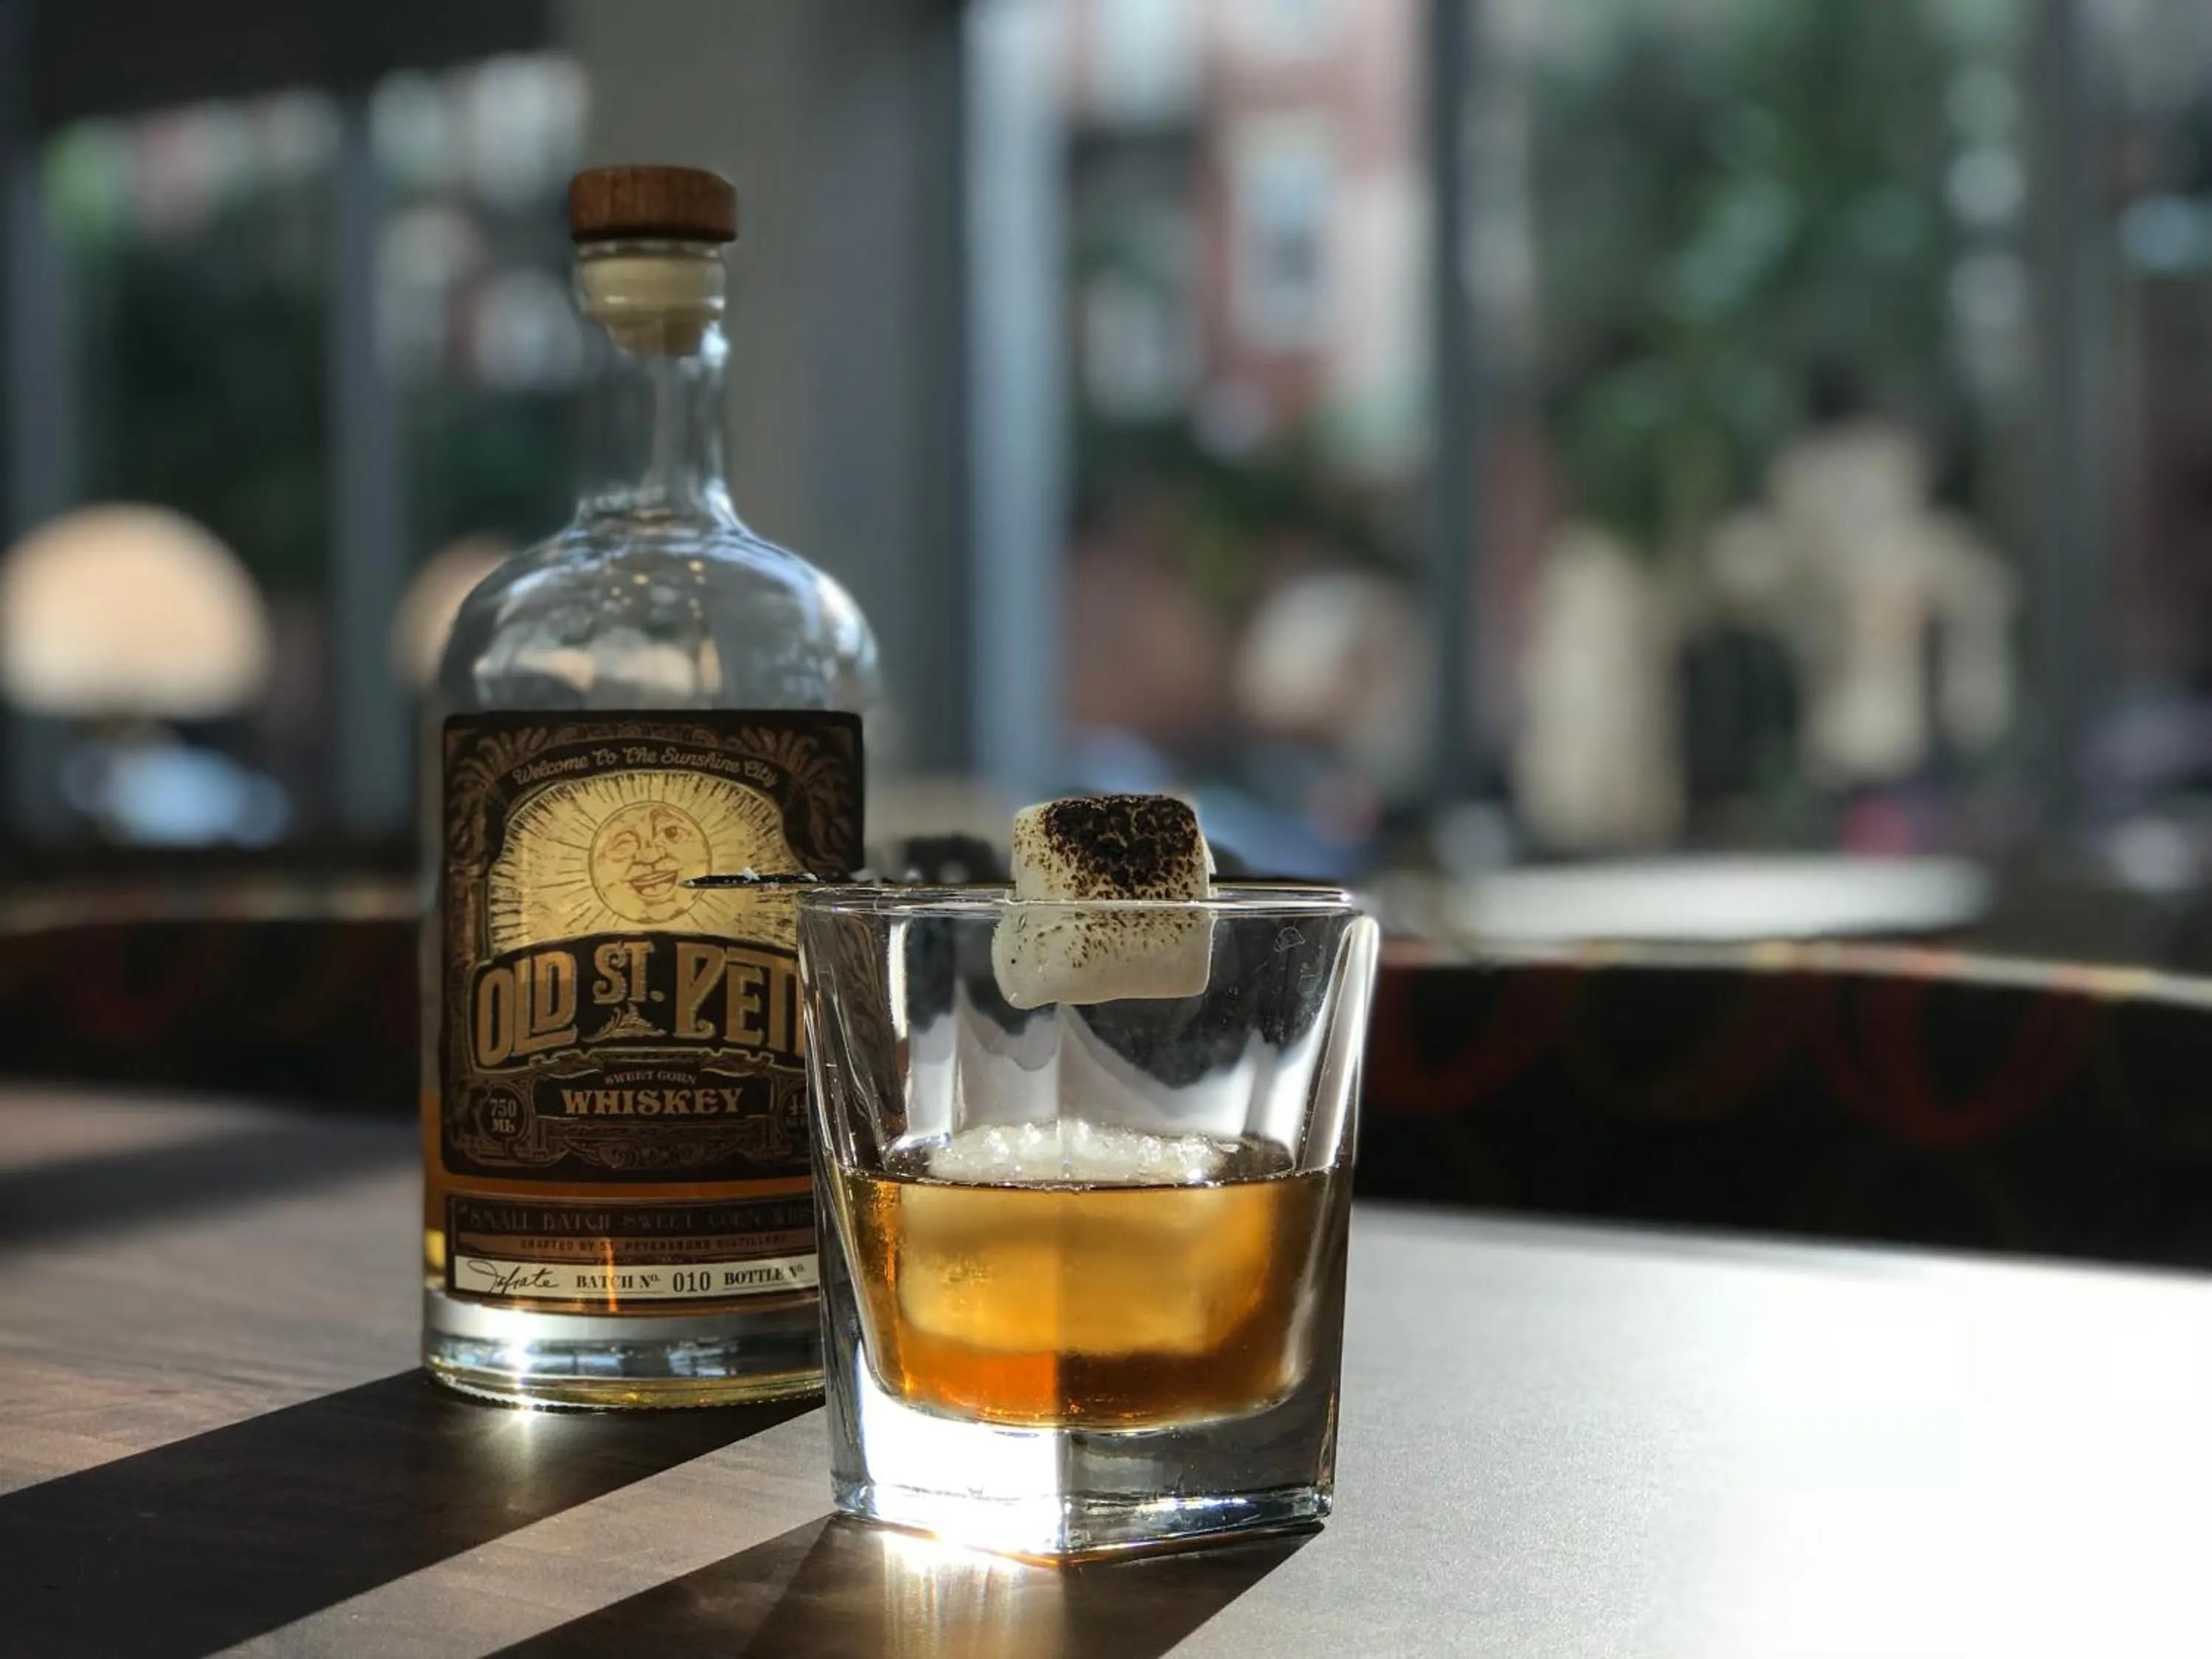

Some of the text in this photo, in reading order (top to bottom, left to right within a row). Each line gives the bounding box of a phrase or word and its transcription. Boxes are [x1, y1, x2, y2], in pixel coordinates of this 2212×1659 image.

[512, 745, 778, 788] Welcome To The Sunshine City
[478, 950, 578, 1067] OLD
[592, 941, 664, 1004] ST.
[604, 1071, 698, 1085] SWEET CORN
[490, 1098, 518, 1118] 750
[560, 1088, 743, 1115] WHISKEY
[543, 1211, 611, 1231] BATCH
[521, 1239, 574, 1252] CRAFTED
[576, 1274, 633, 1289] BATCH
[672, 1270, 712, 1293] 010
[723, 1267, 785, 1286] BOTTLE
